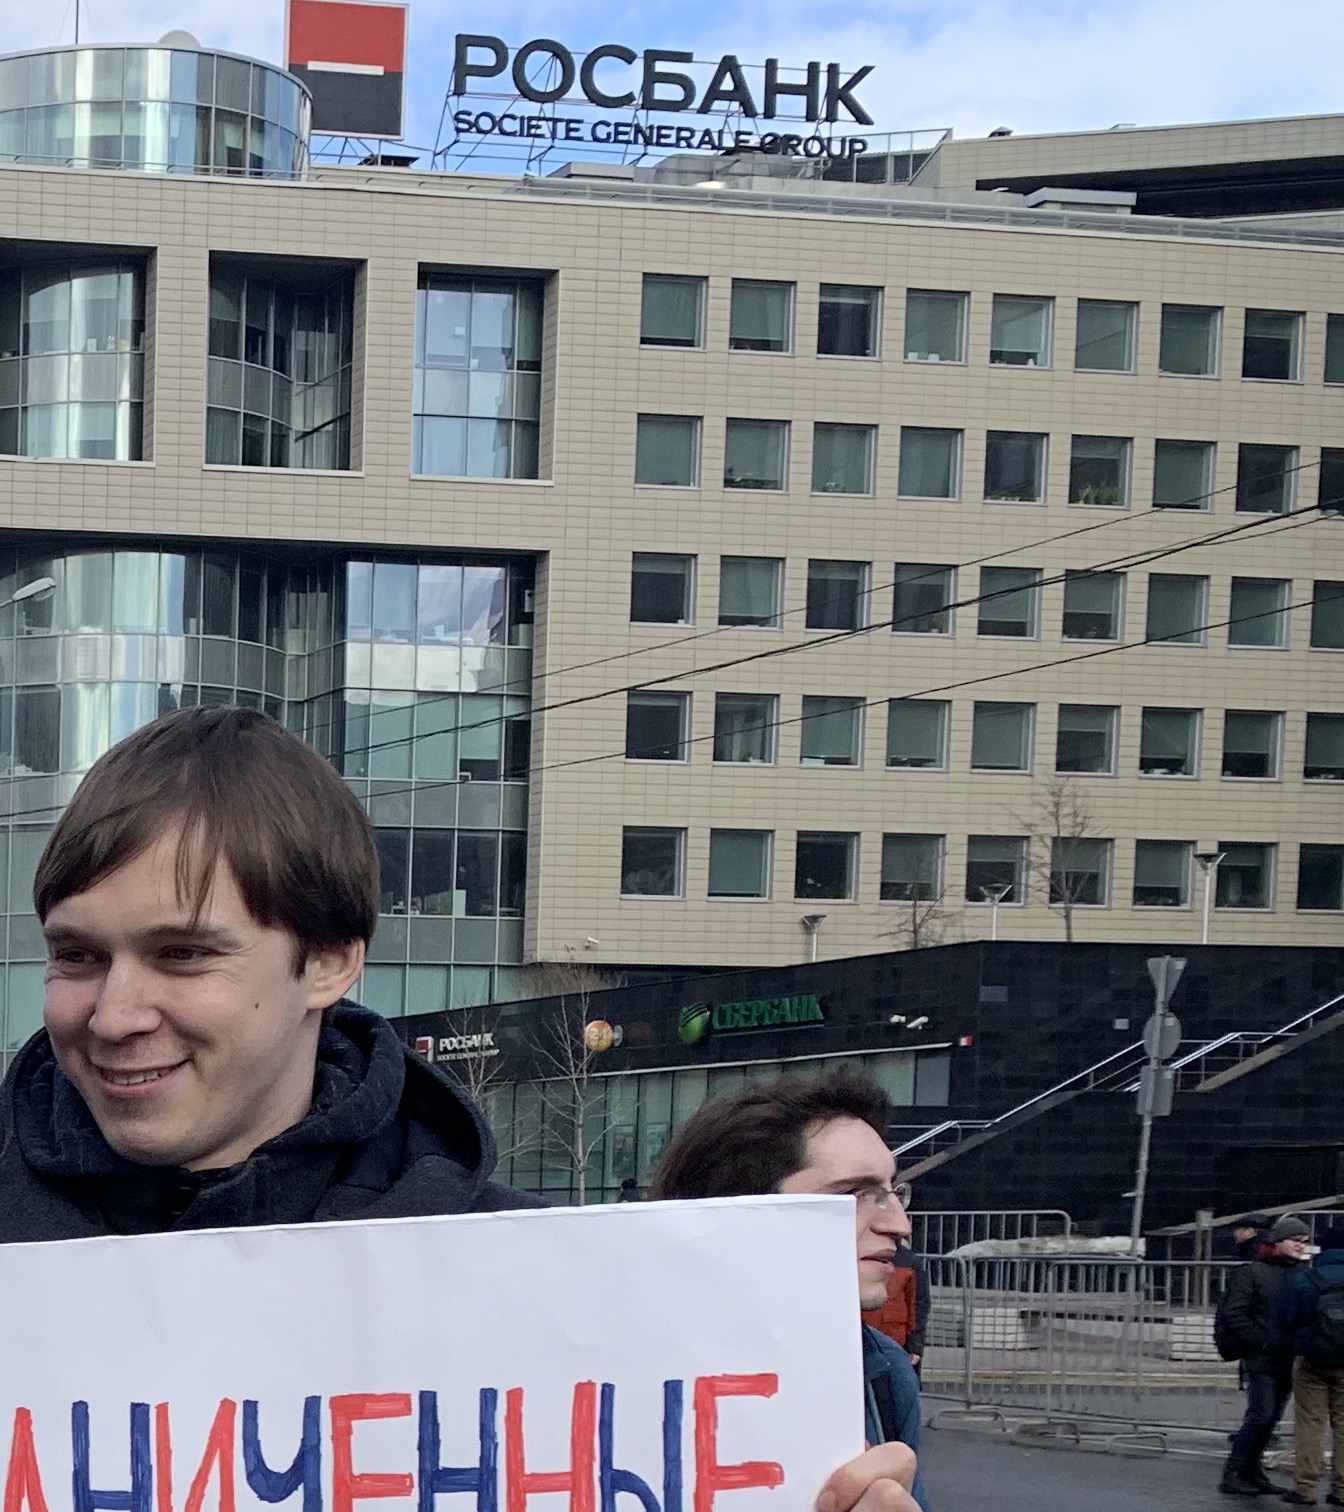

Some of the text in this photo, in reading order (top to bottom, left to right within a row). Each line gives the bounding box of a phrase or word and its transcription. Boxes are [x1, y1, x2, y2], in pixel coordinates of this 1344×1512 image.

[454, 33, 876, 126] РОСБАНК
[454, 109, 869, 160] SOCIETE GENERALE GROUP
[713, 994, 825, 1029] СБЕРБАНК
